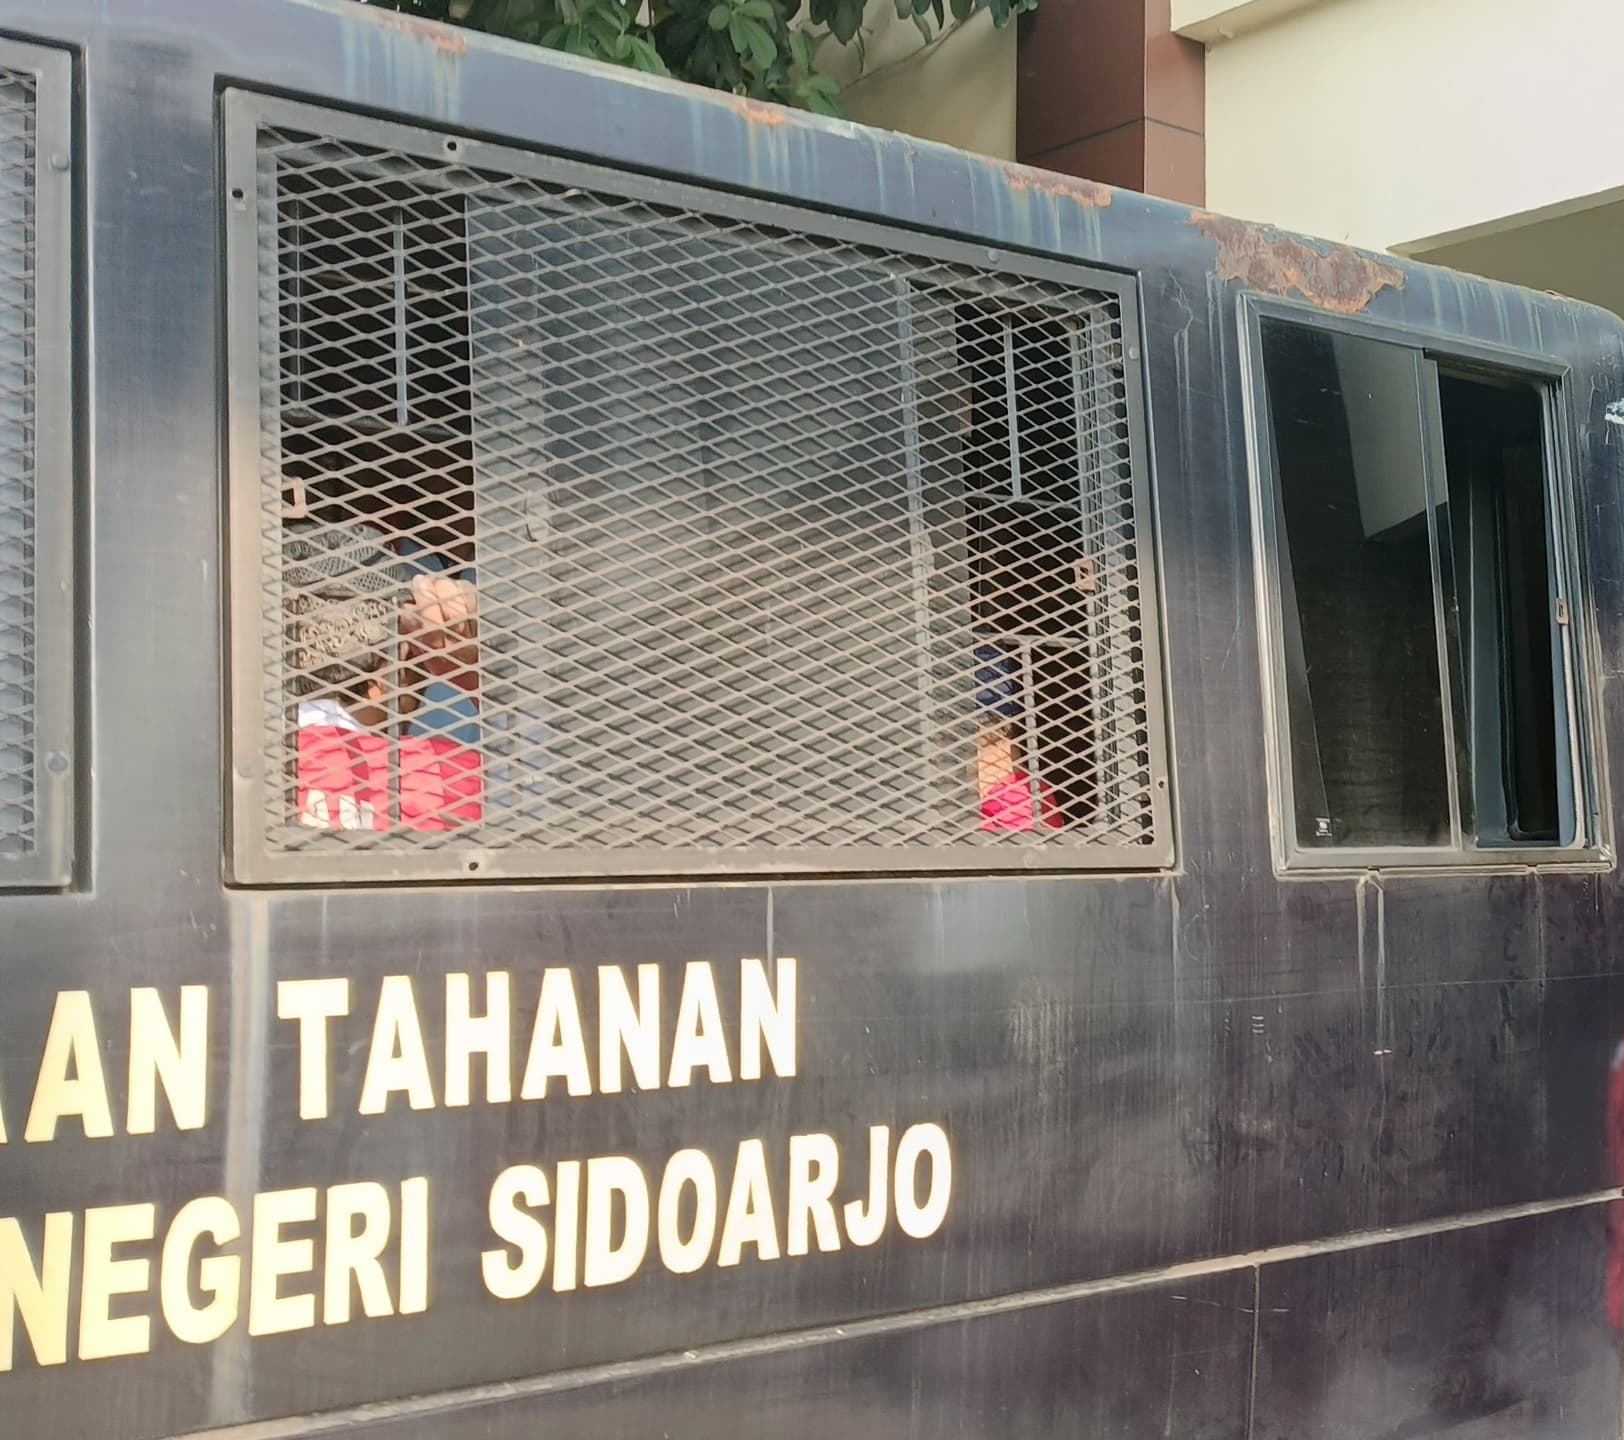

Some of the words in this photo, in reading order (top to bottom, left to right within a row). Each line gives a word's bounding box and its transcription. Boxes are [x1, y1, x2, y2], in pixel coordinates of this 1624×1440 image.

[0, 983, 209, 1144] AN
[276, 957, 798, 1121] TAHANAN
[0, 1175, 431, 1371] NEGERI
[480, 1122, 953, 1301] SIDOARJO
